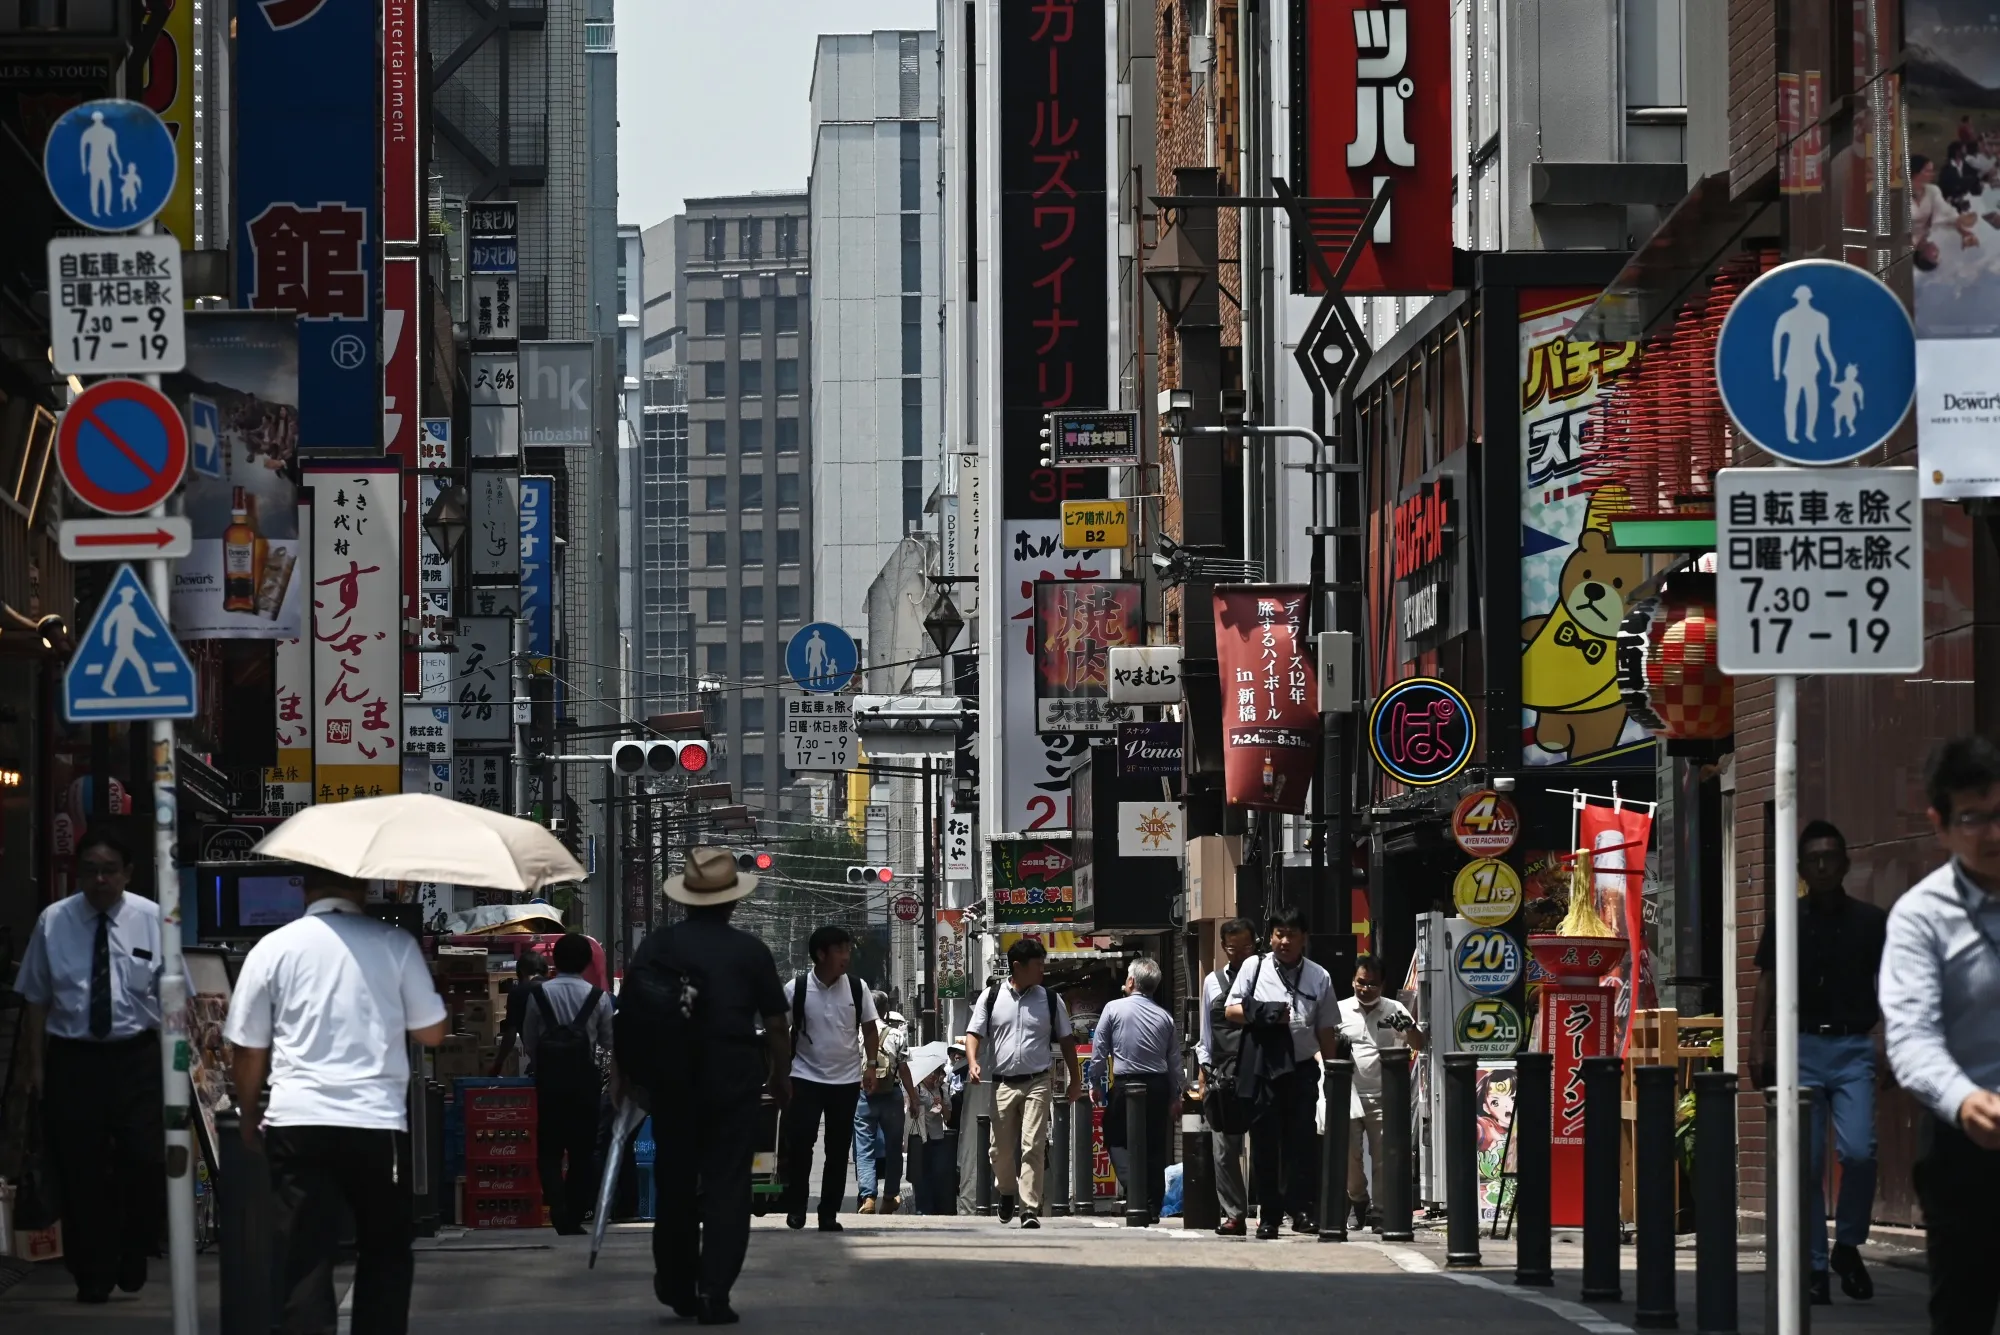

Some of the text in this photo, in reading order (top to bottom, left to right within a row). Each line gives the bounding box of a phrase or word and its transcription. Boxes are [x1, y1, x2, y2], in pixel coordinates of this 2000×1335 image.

[392, 0, 407, 142] ntertainment
[60, 252, 171, 277] 自転車を除く
[62, 281, 172, 306] 日曜・休日を除く
[148, 307, 165, 332] 9
[73, 336, 100, 361] 17
[140, 335, 168, 360] 19
[1730, 491, 1912, 526] 自転車を除く
[1086, 531, 1105, 542] B2
[1730, 536, 1911, 571] 日曜・休日を除く
[175, 573, 214, 587] Dewar's
[1866, 577, 1890, 612] 9
[1750, 617, 1793, 654] 17
[1848, 617, 1891, 654] 19
[1257, 601, 1282, 722] 旅するハイボール
[1284, 600, 1306, 705] デュワーズ12年
[1115, 665, 1176, 686] やまむら
[1236, 667, 1254, 683] in
[789, 700, 853, 713] 自転車を除く
[1237, 688, 1257, 722] 新橋
[409, 726, 443, 737] 株式会社
[1126, 727, 1151, 735] スナック
[1390, 698, 1456, 764] ぱ
[838, 736, 848, 749] 9
[1124, 739, 1183, 759] Venus
[797, 752, 811, 765] 17
[831, 752, 846, 765] 19
[1126, 764, 1136, 772] 2F
[1027, 796, 1071, 831] 2
[1140, 823, 1171, 832] NIKA
[1465, 836, 1510, 845] 4YEN PACHINKO
[896, 903, 917, 915] 消火栓
[999, 905, 1072, 915] ファッションヘルス
[1560, 947, 1603, 967] 屋台
[1469, 974, 1511, 982] 20YEN SLOT
[1470, 1043, 1510, 1052] 5YEN SLOT
[1562, 1004, 1592, 1119] ラーメン
